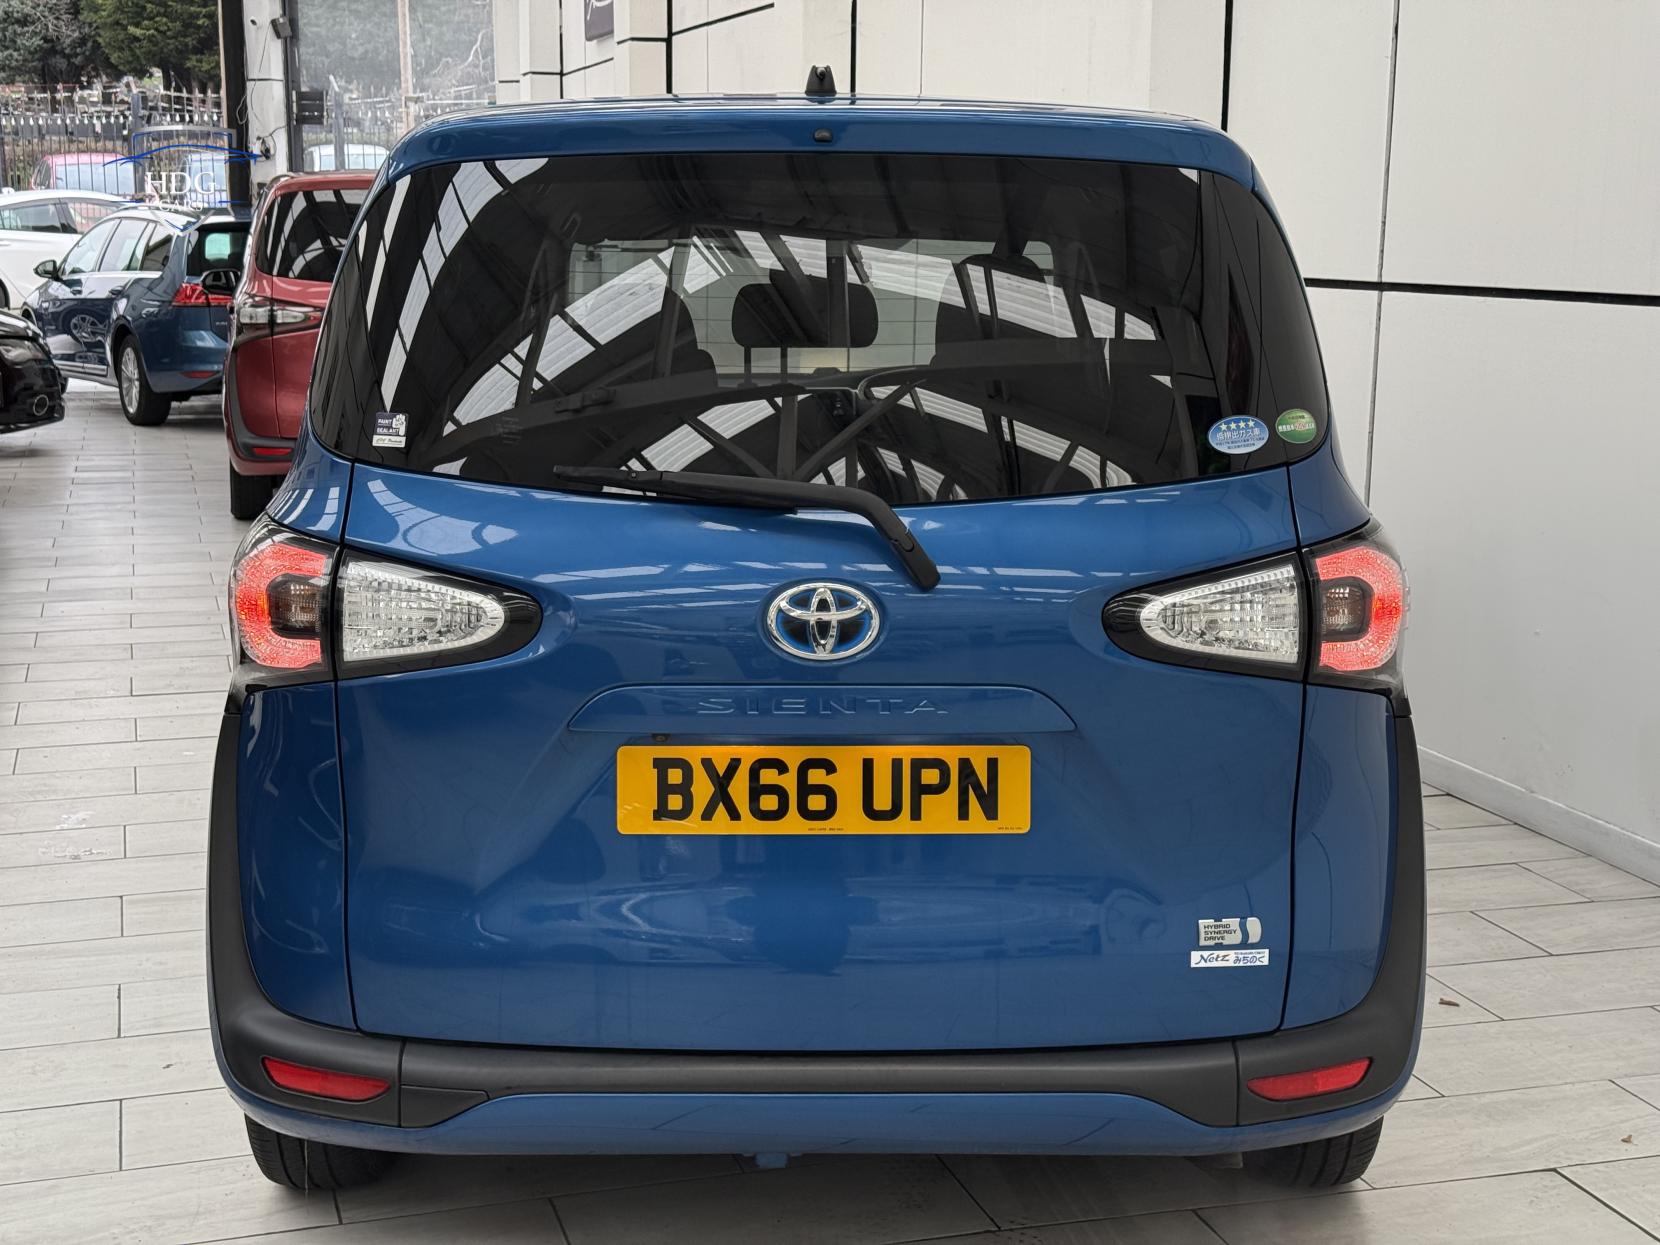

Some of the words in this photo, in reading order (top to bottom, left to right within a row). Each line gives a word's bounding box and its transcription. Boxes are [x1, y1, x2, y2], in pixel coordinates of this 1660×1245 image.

[697, 698, 949, 714] SIENTA
[652, 757, 838, 822] BX66
[861, 757, 999, 822] UPN
[1203, 928, 1237, 936] SYNERGY
